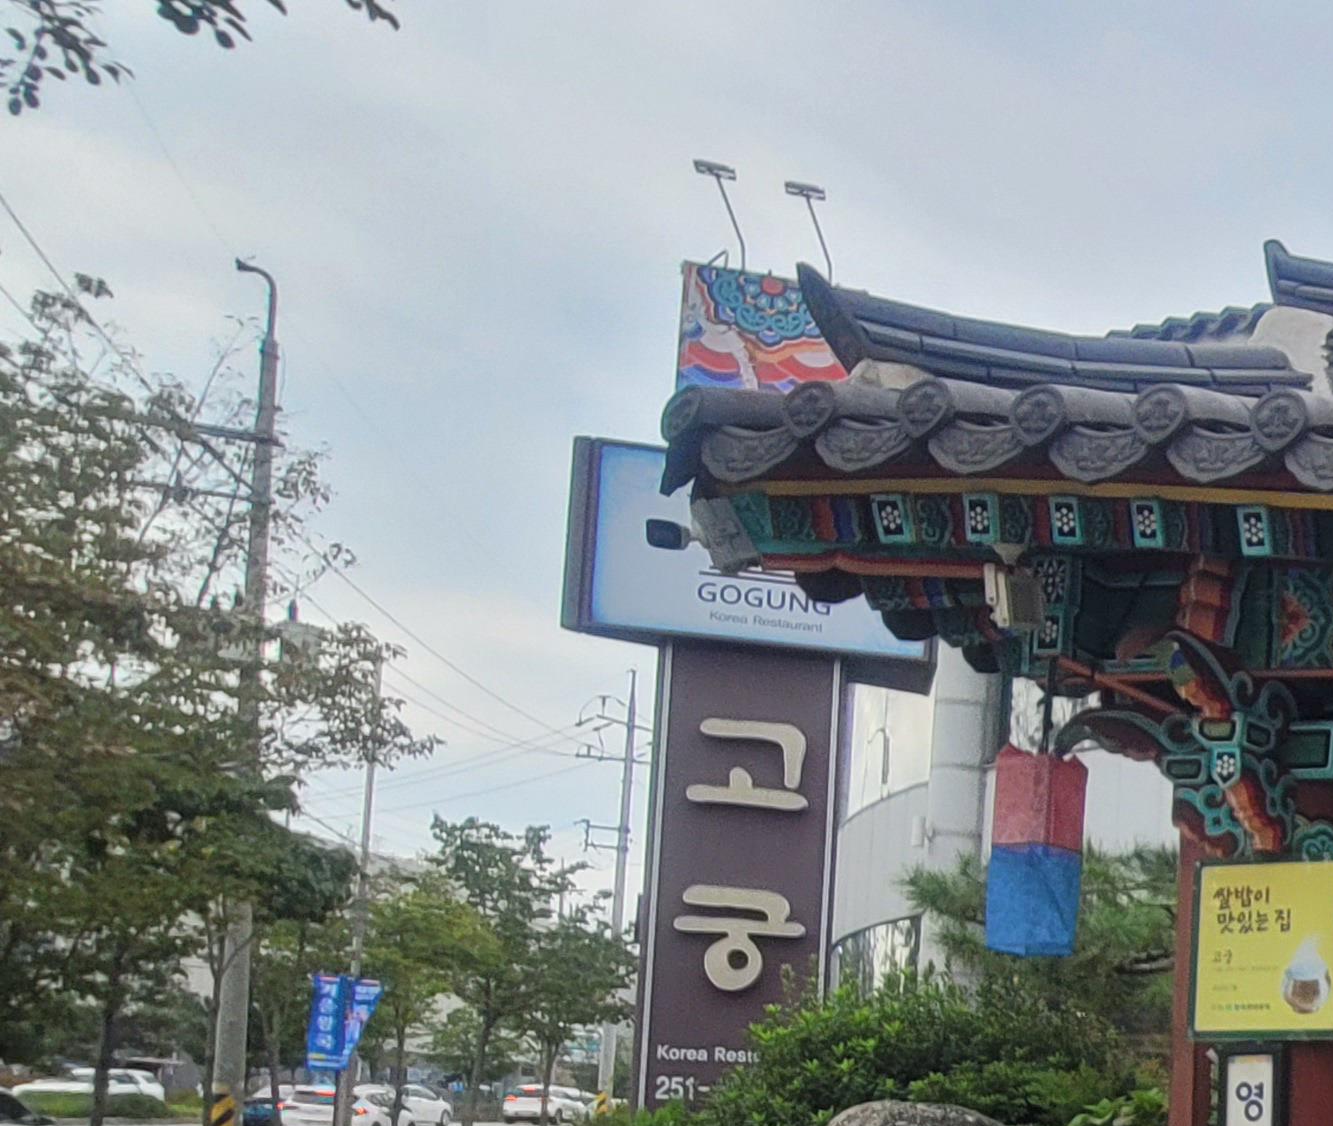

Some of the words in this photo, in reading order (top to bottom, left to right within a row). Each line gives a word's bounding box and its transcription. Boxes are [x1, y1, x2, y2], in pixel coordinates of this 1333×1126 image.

[697, 582, 831, 616] GOGUNG
[709, 610, 748, 625] Korea
[753, 615, 823, 633] Restaurant
[672, 717, 809, 992] 고궁
[1213, 885, 1270, 910] 쌀밥이
[1217, 911, 1269, 934] 맛있는
[1275, 908, 1291, 932] 집
[657, 1044, 708, 1062] Korea
